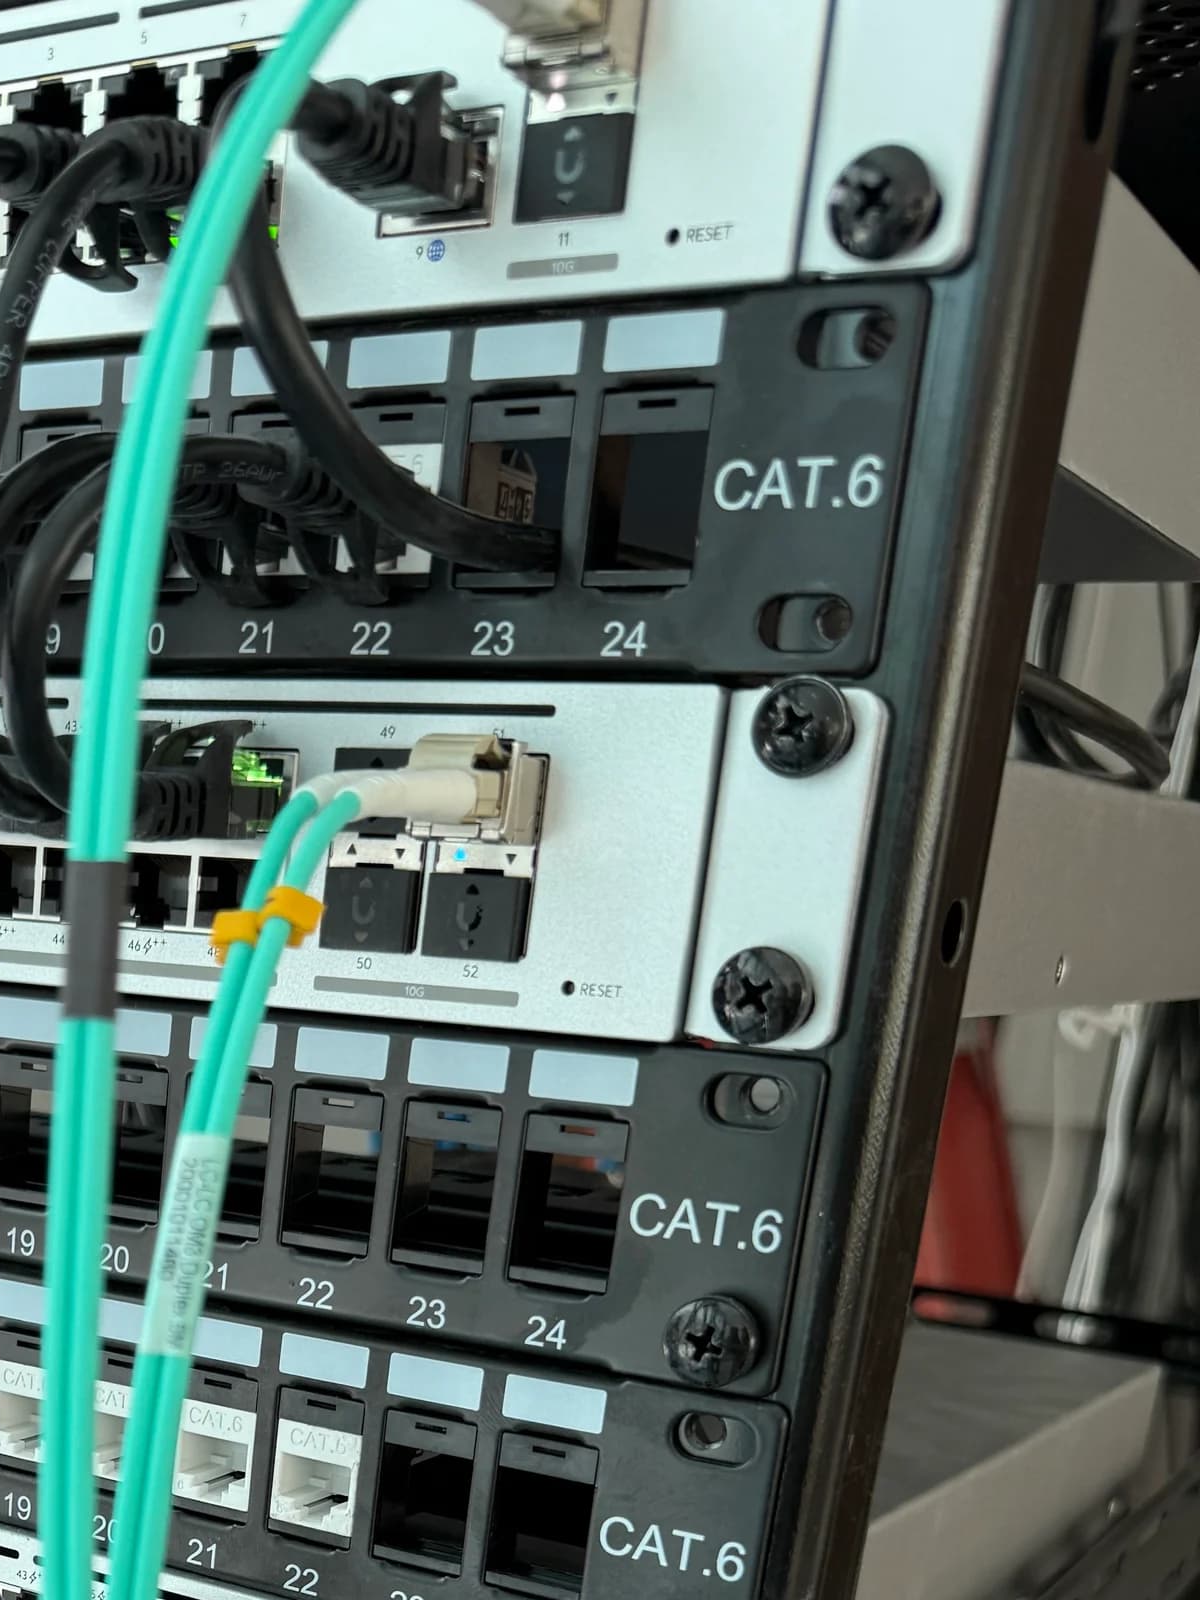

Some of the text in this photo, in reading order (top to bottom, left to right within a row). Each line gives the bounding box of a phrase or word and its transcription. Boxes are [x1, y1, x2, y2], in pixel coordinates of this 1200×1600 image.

[557, 232, 570, 248] 11
[685, 224, 735, 244] RESET
[551, 260, 576, 275] 10G
[713, 453, 886, 512] CAT.6
[238, 619, 275, 656] 21
[349, 619, 393, 657] 22
[470, 619, 516, 657] 23
[600, 619, 649, 658] 24
[379, 725, 397, 739] 49
[356, 956, 373, 971] 50
[461, 964, 480, 980] 52
[579, 981, 624, 999] RESET
[628, 1192, 785, 1255] CAT.6
[6, 1226, 36, 1257] 19
[100, 1243, 130, 1274] 20
[296, 1277, 336, 1311] 22
[405, 1295, 447, 1330] 23
[524, 1315, 567, 1351] 24
[2, 1367, 46, 1392] CAT.
[3, 1491, 32, 1521] 19
[185, 1537, 218, 1570] 21
[282, 1563, 320, 1598] 22
[598, 1515, 749, 1583] CAT.6
